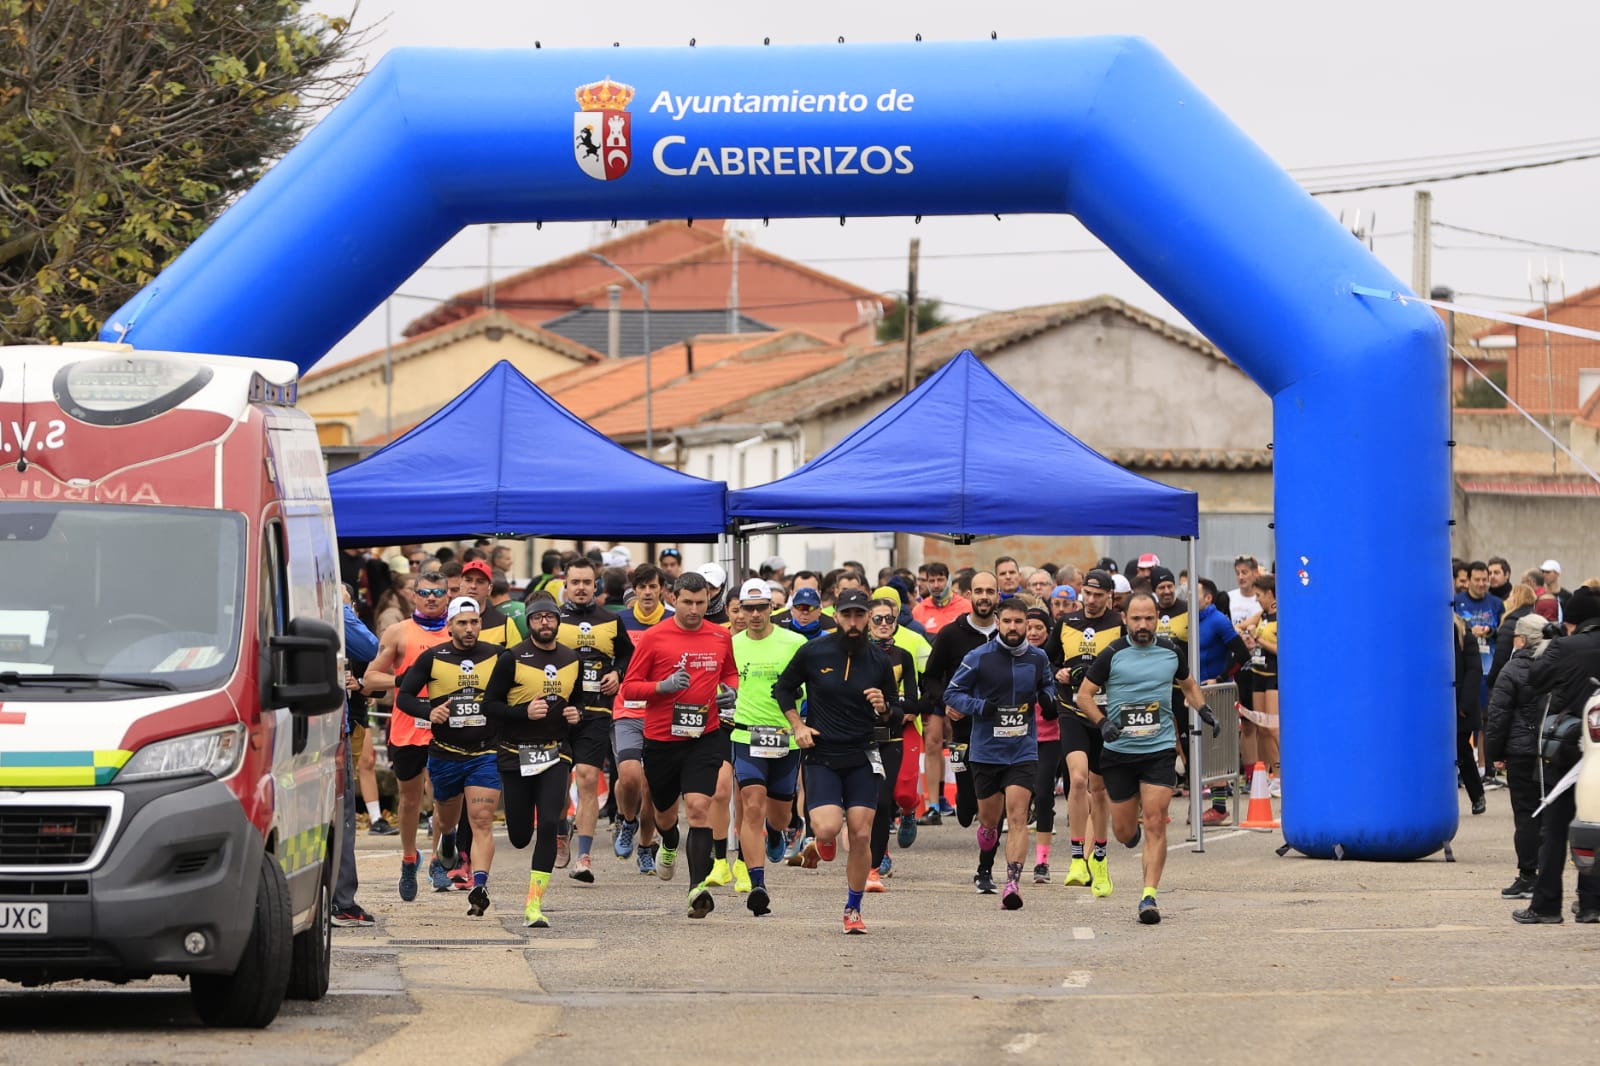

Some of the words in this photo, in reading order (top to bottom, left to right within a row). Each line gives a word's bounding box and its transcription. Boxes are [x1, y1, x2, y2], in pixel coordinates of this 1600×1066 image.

[649, 89, 868, 121] Ayuntamiento
[876, 88, 915, 112] de
[652, 135, 914, 176] CABRERIZOS
[456, 703, 480, 715] 359
[680, 713, 703, 726] 339
[1000, 714, 1024, 726] 342
[1127, 712, 1153, 725] 348
[759, 734, 781, 746] 331
[528, 750, 550, 763] 341
